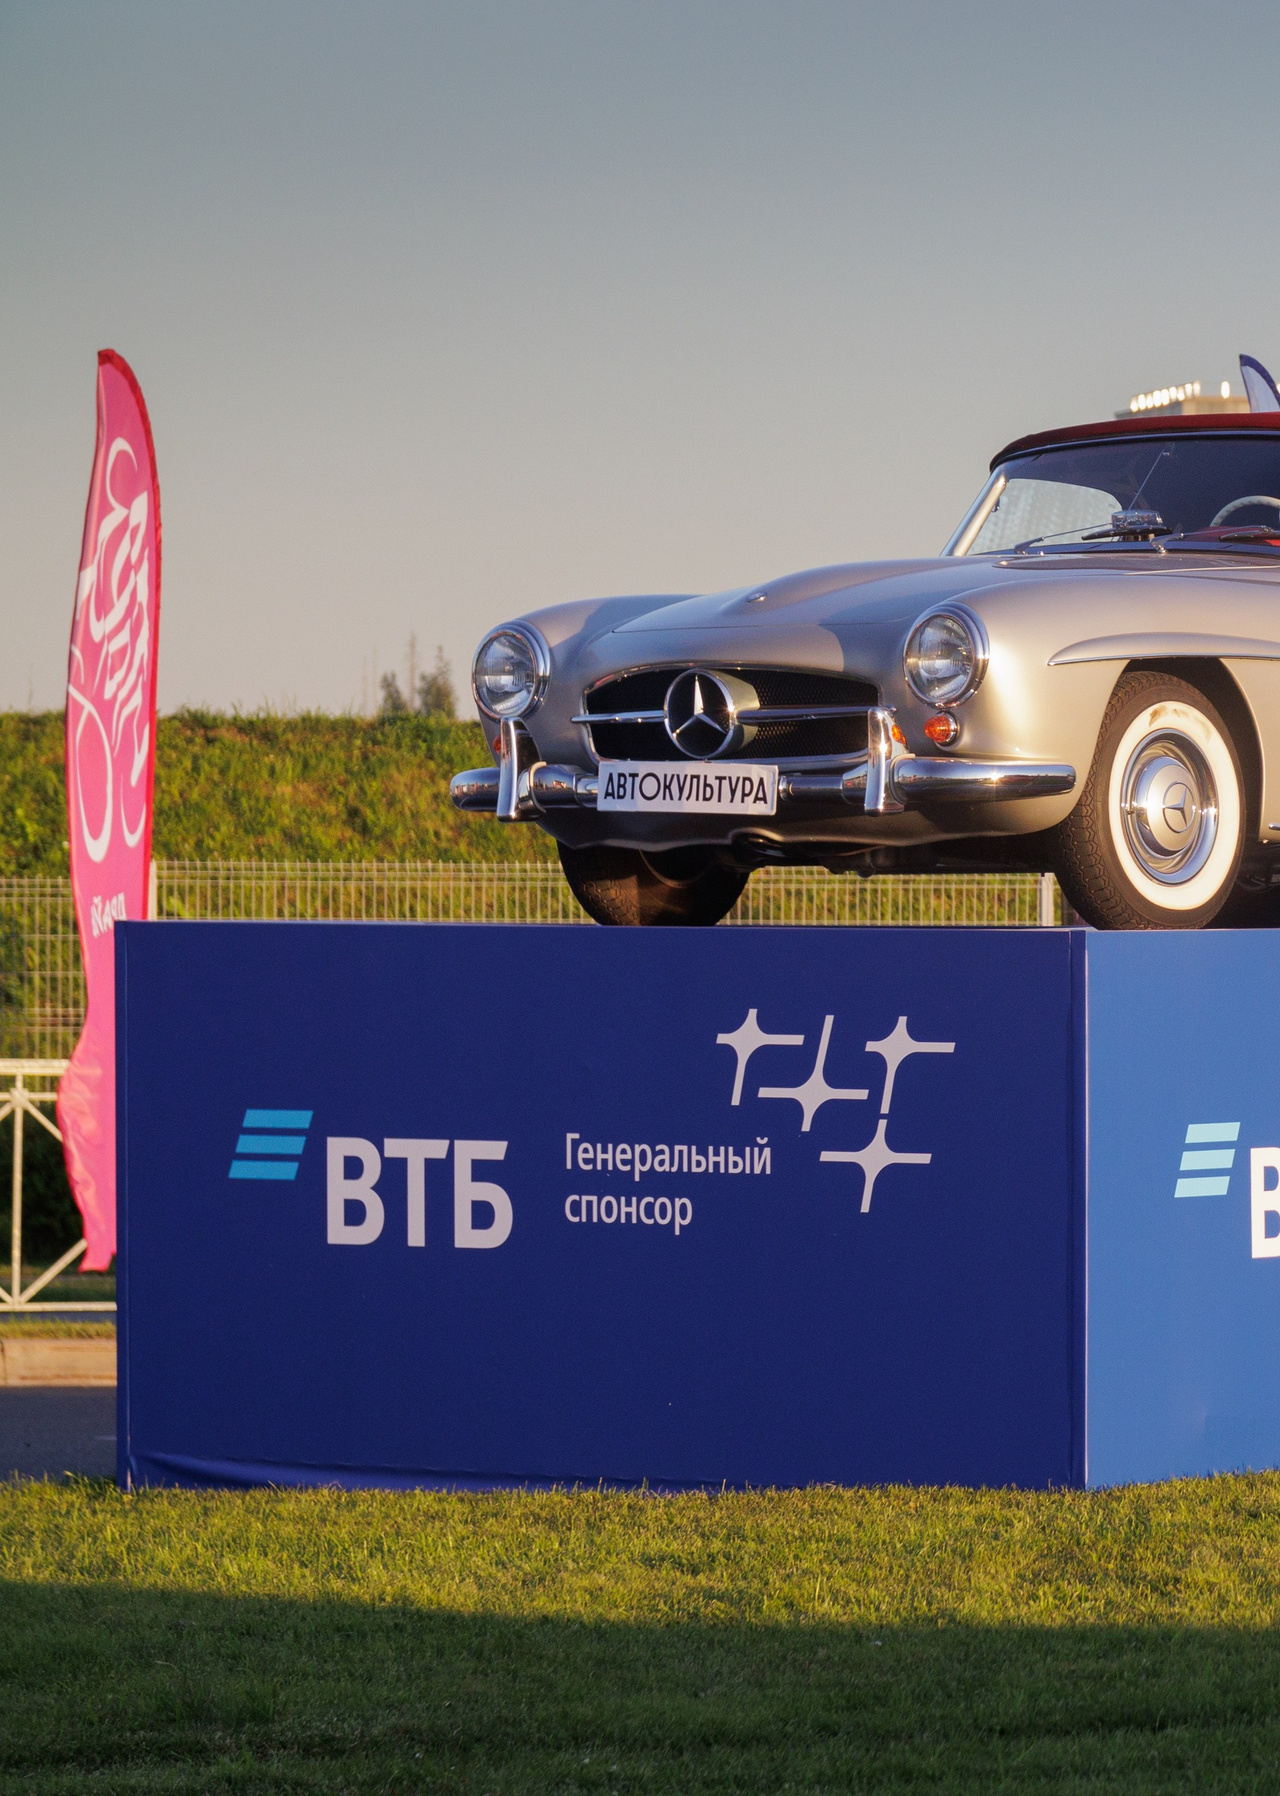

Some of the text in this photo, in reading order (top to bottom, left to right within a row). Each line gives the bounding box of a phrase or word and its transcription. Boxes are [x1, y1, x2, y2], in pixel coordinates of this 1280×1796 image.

[603, 771, 768, 805] АВТОКУЛЬТУРА
[564, 1132, 773, 1181] Генеральный
[325, 1135, 514, 1249] ВТБ
[564, 1190, 693, 1236] спонсор
